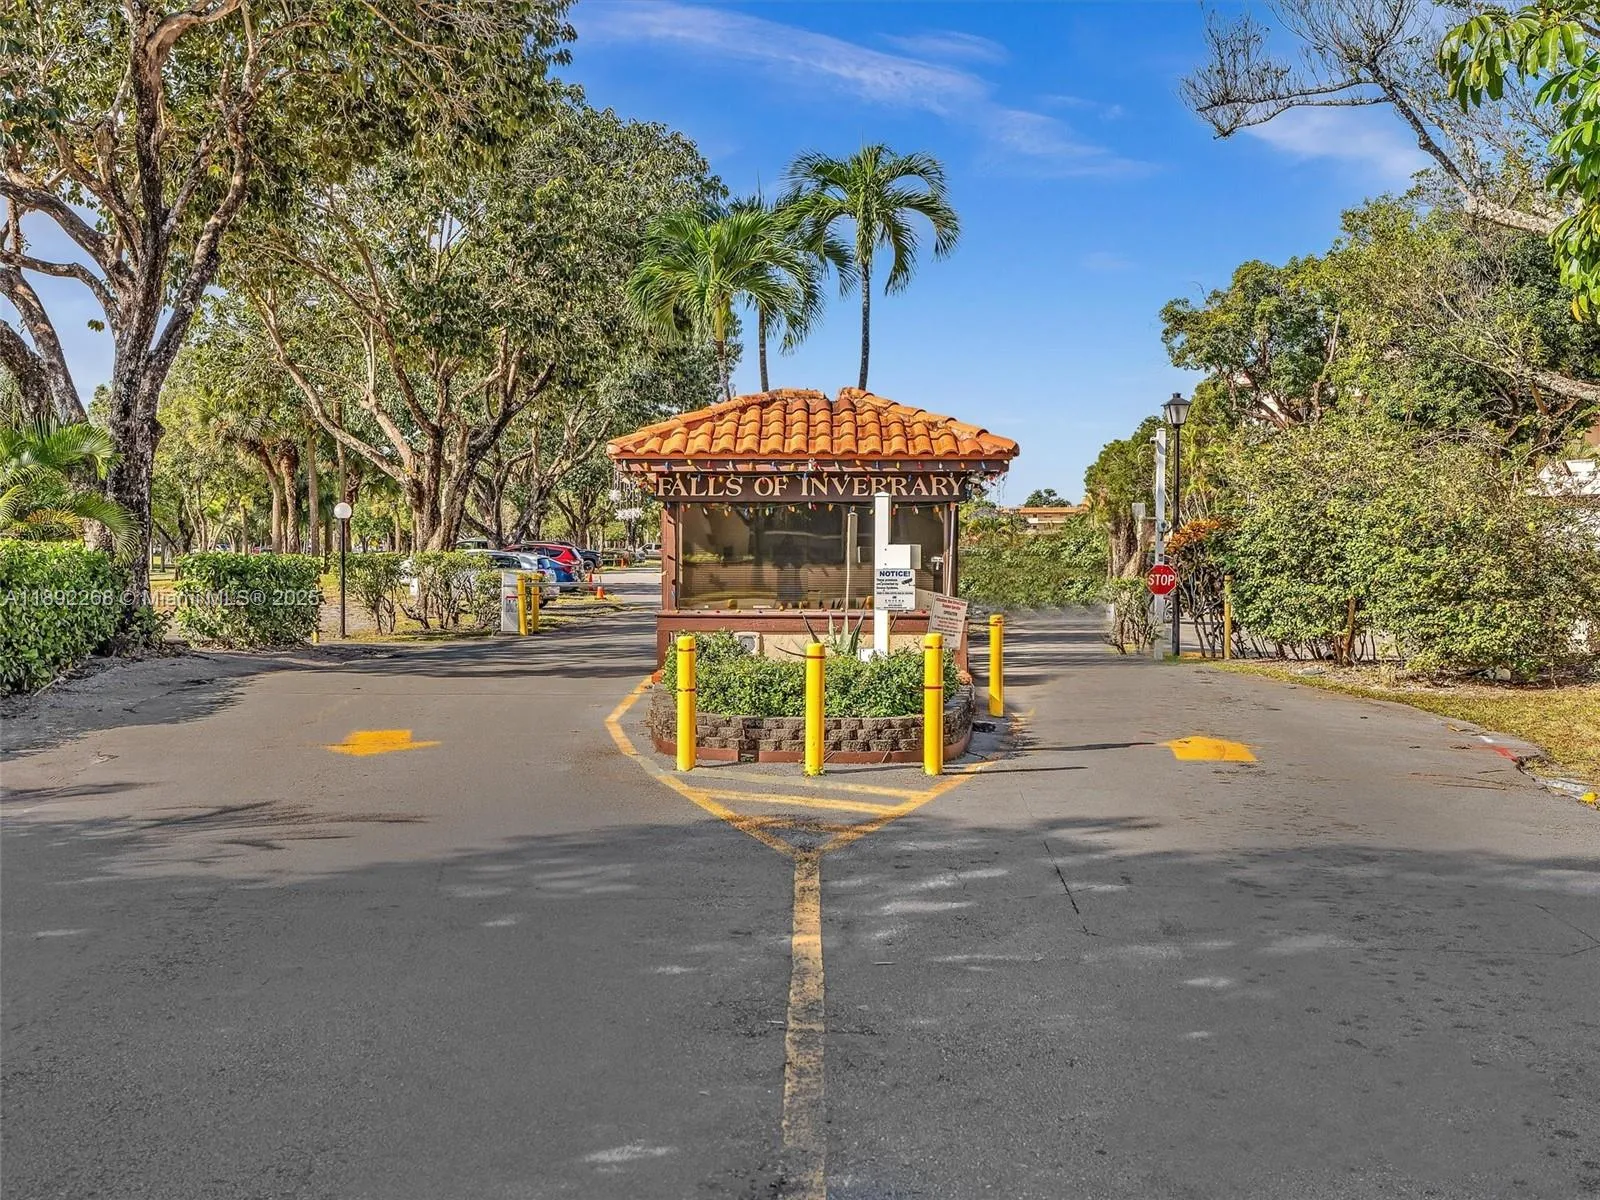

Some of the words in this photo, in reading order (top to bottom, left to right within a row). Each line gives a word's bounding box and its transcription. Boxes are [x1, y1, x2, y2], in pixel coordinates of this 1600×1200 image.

[656, 476, 743, 497] FALLS
[753, 477, 788, 497] OF
[801, 476, 964, 497] INVERRARY
[1148, 574, 1175, 586] STOP
